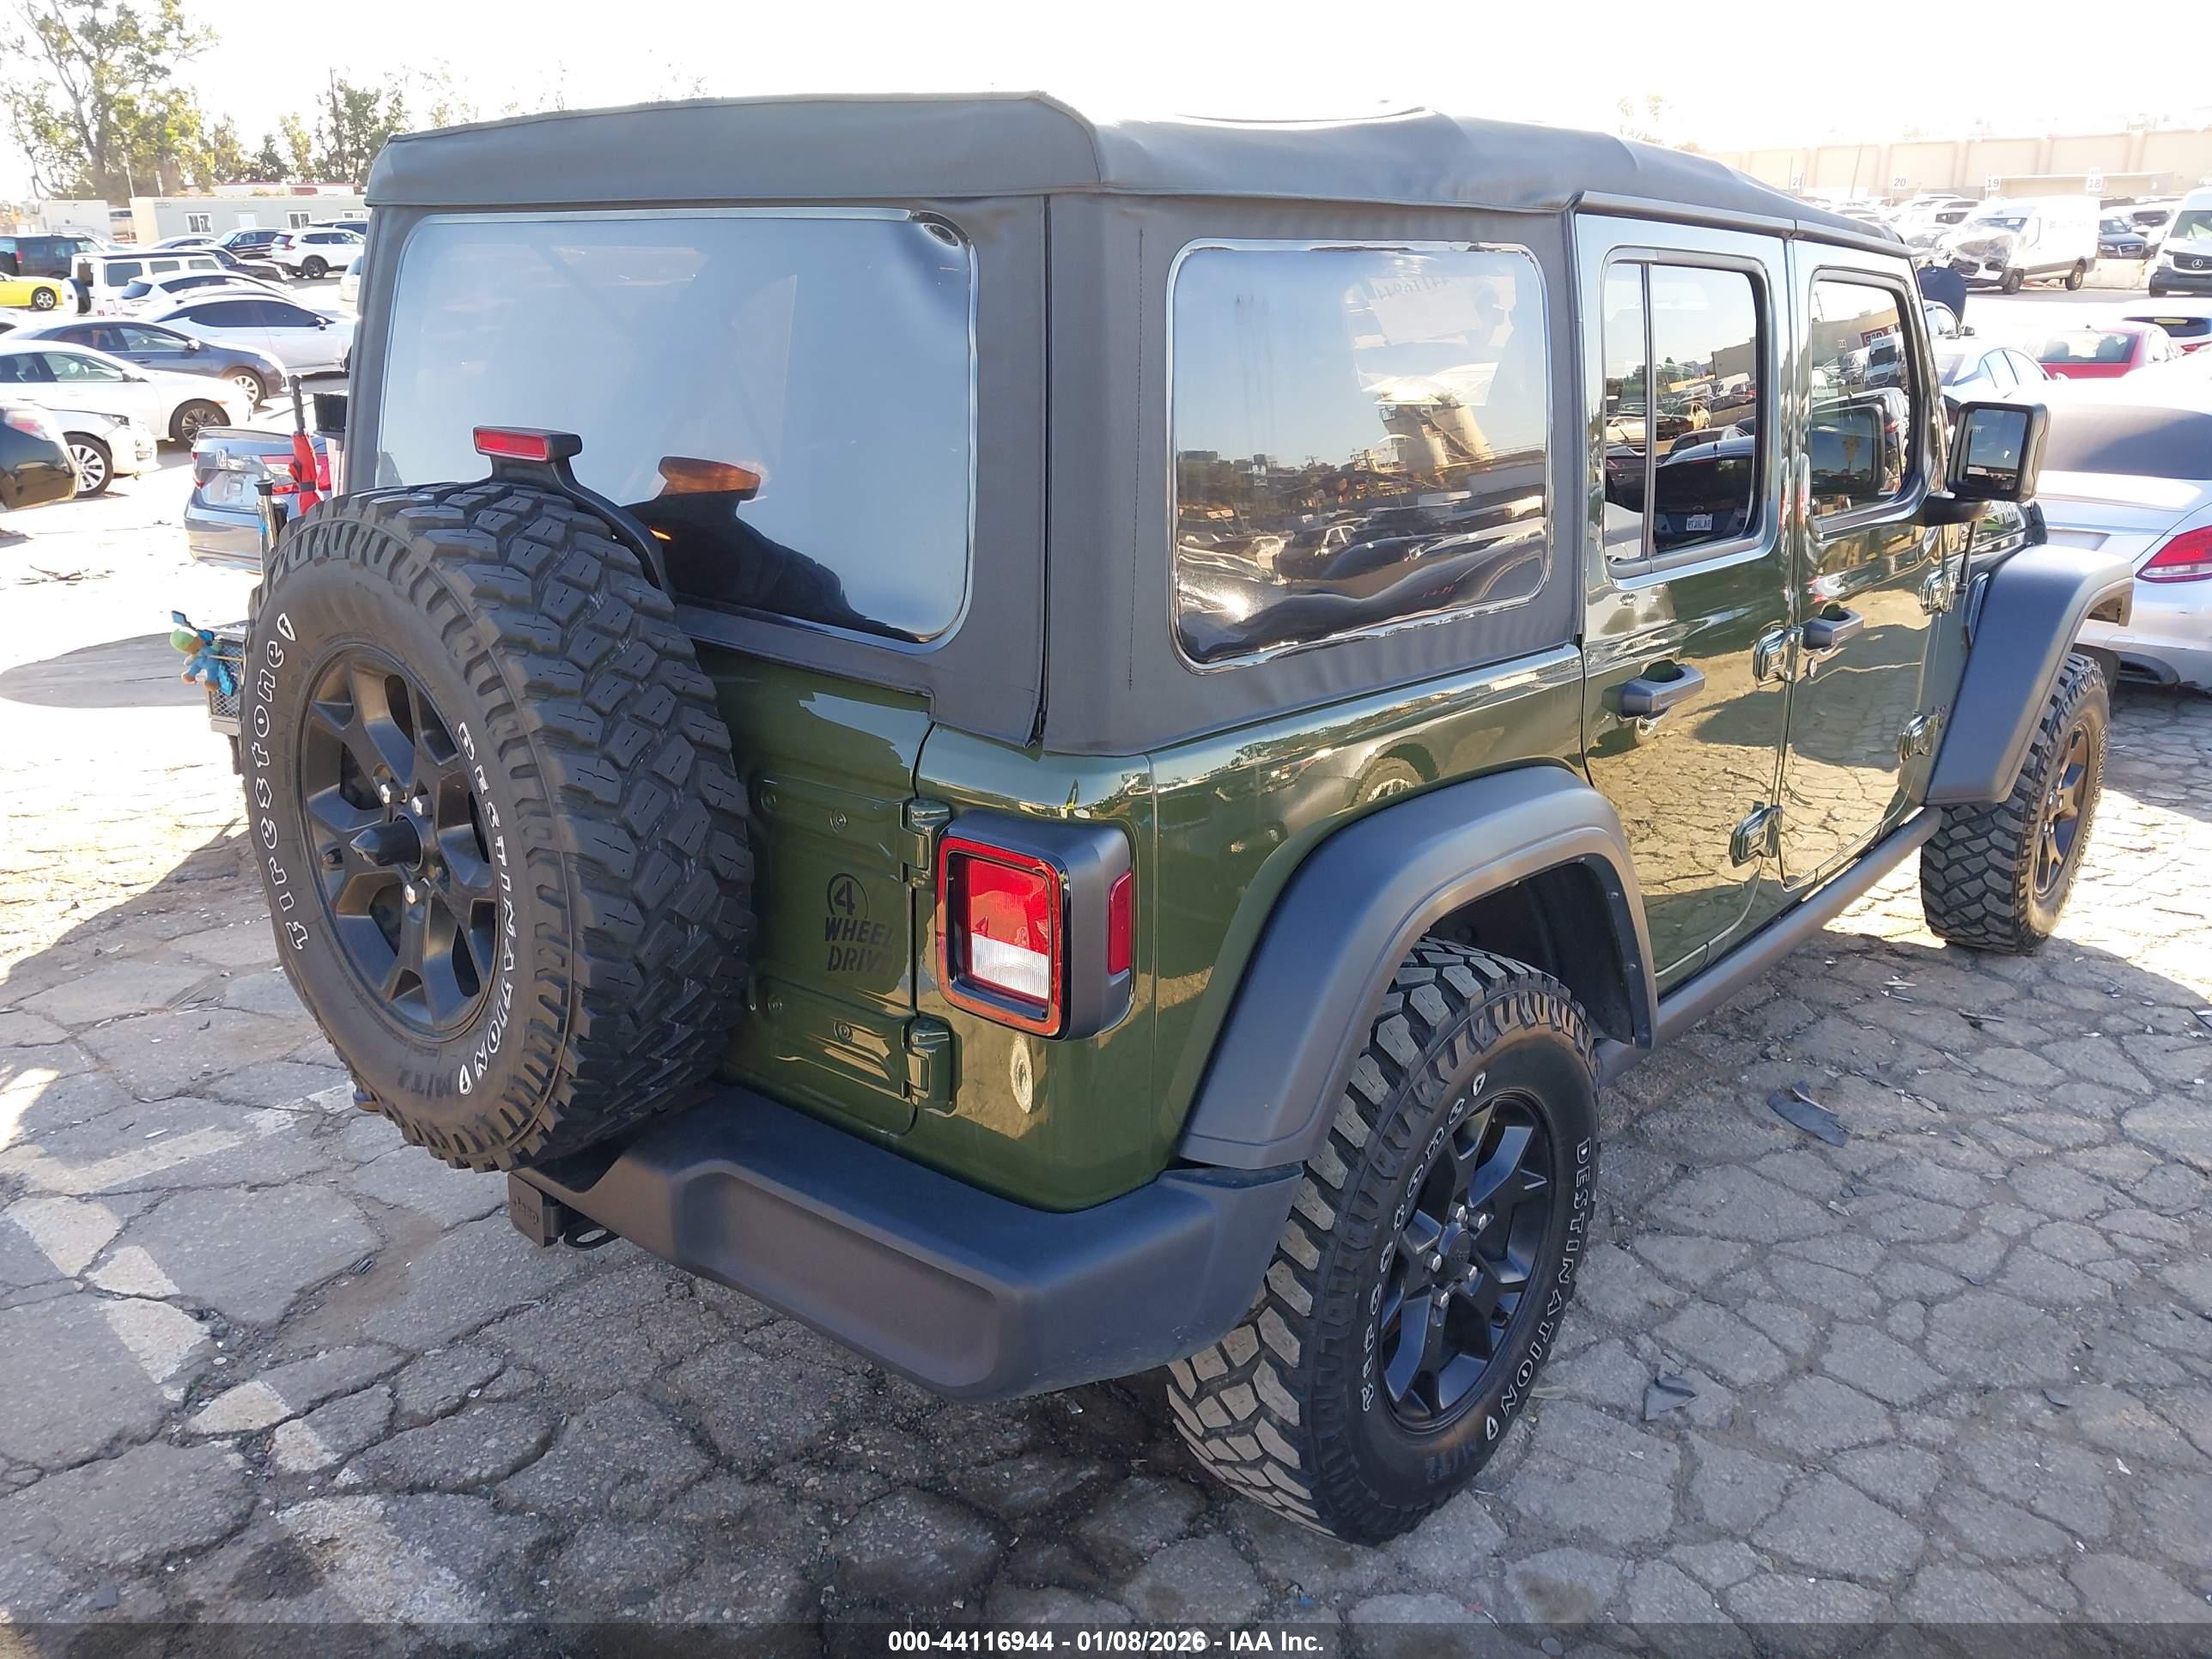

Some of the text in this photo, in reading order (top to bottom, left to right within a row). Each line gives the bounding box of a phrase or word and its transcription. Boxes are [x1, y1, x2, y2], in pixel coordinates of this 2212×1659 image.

[1893, 178, 1906, 187] 20
[1986, 179, 1999, 188] 19
[2087, 179, 2101, 188] 18
[251, 641, 309, 951] Firestone
[457, 720, 517, 1081] DESTINATION
[833, 880, 856, 916] 4
[1499, 1136, 1592, 1418] DESTINATION
